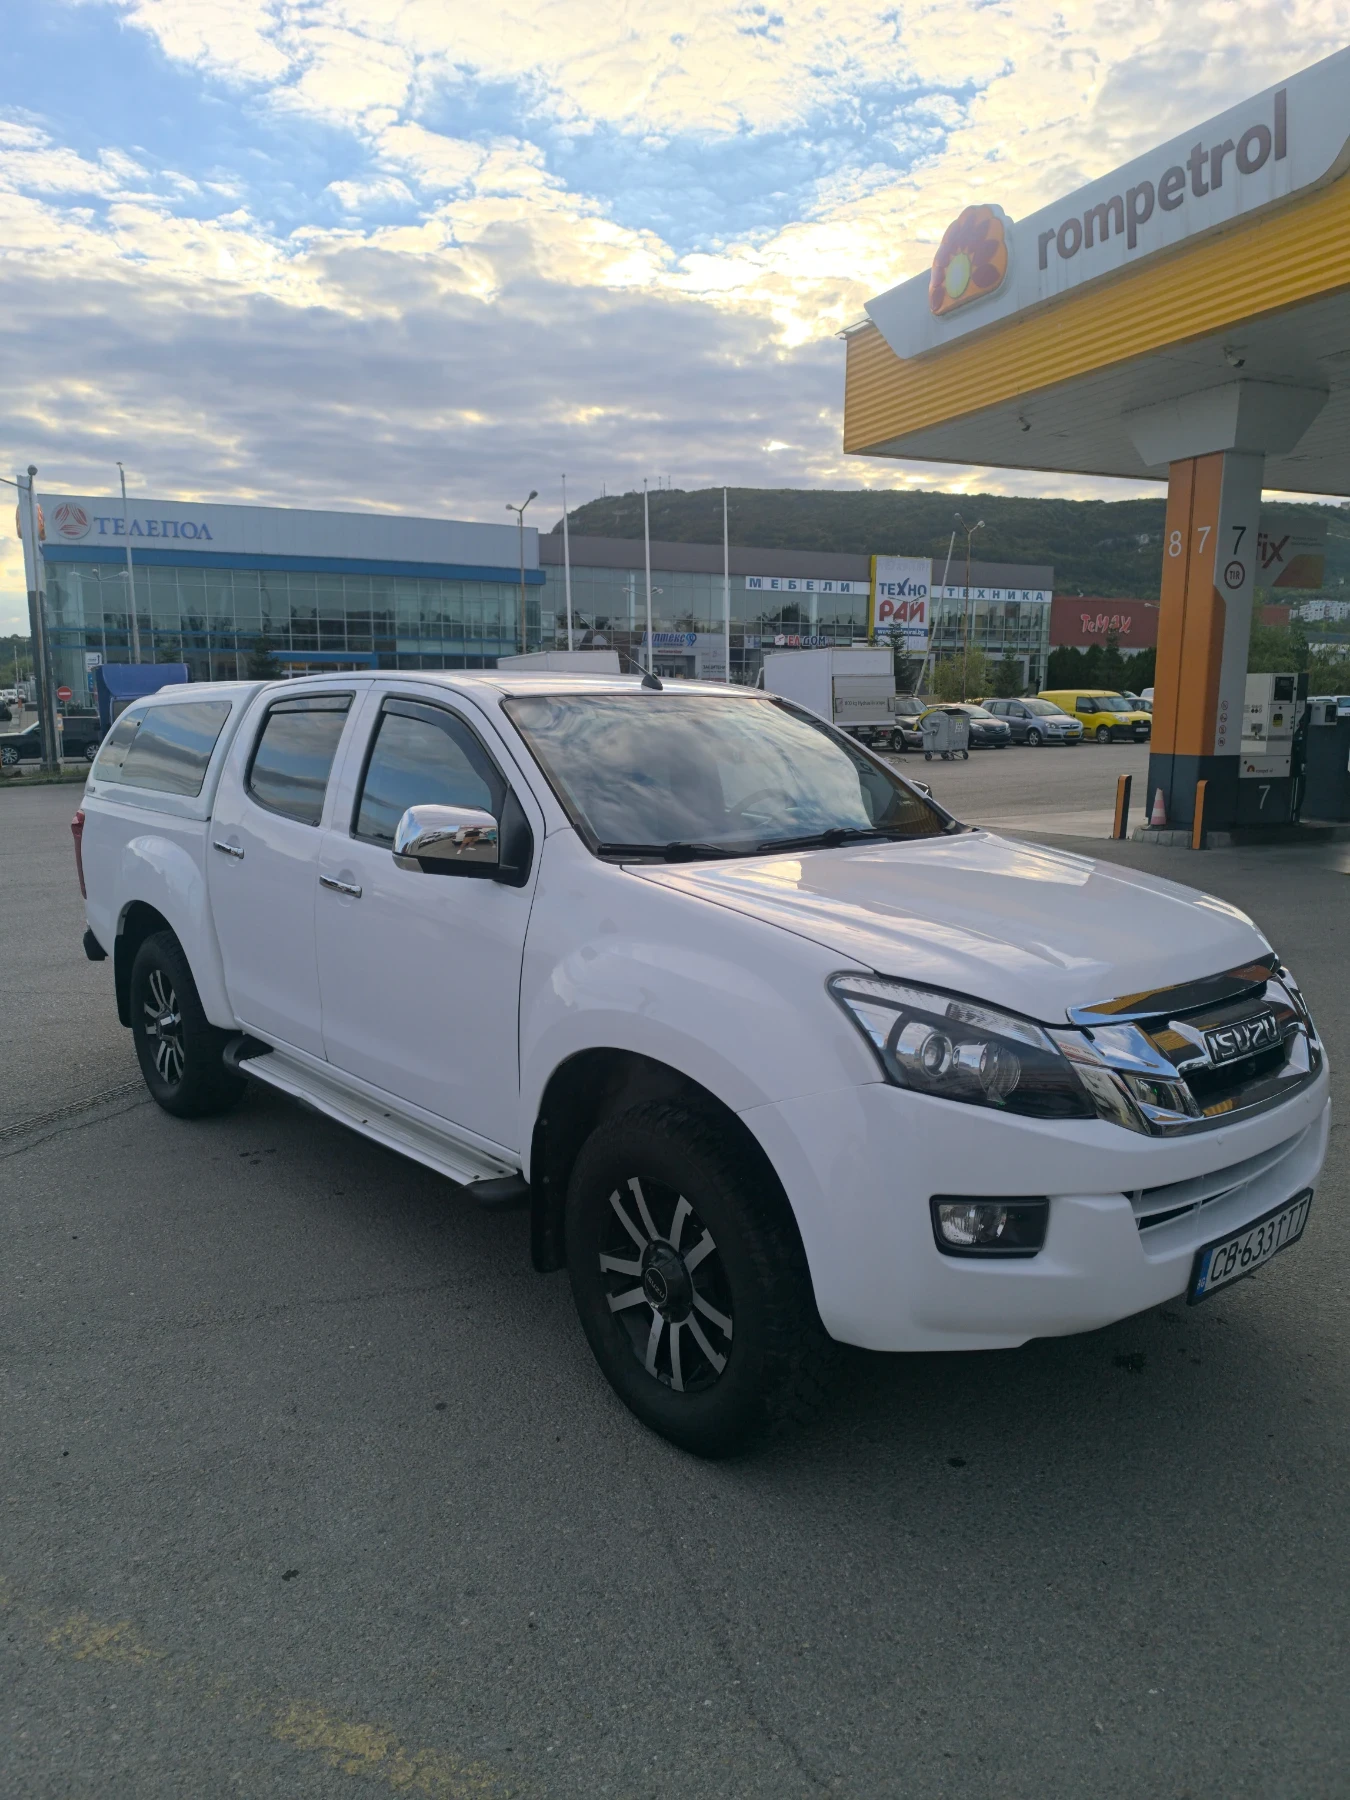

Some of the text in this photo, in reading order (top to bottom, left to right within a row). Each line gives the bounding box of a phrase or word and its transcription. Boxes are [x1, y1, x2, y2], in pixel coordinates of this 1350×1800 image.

[1038, 88, 1287, 271] rompetrol
[94, 517, 213, 540] ТЕЛЕПОЛ
[1197, 526, 1211, 554] 7
[1168, 530, 1182, 557] 8
[1232, 526, 1247, 555] 7
[749, 578, 850, 592] МЕБЕЛИ
[879, 577, 927, 596] ТЕХНО
[1229, 570, 1240, 580] TIR
[947, 587, 1043, 601] ТЕХНИКА
[879, 600, 925, 622] РАЙ
[1259, 785, 1270, 809] 7
[1207, 1015, 1278, 1062] ISUZU
